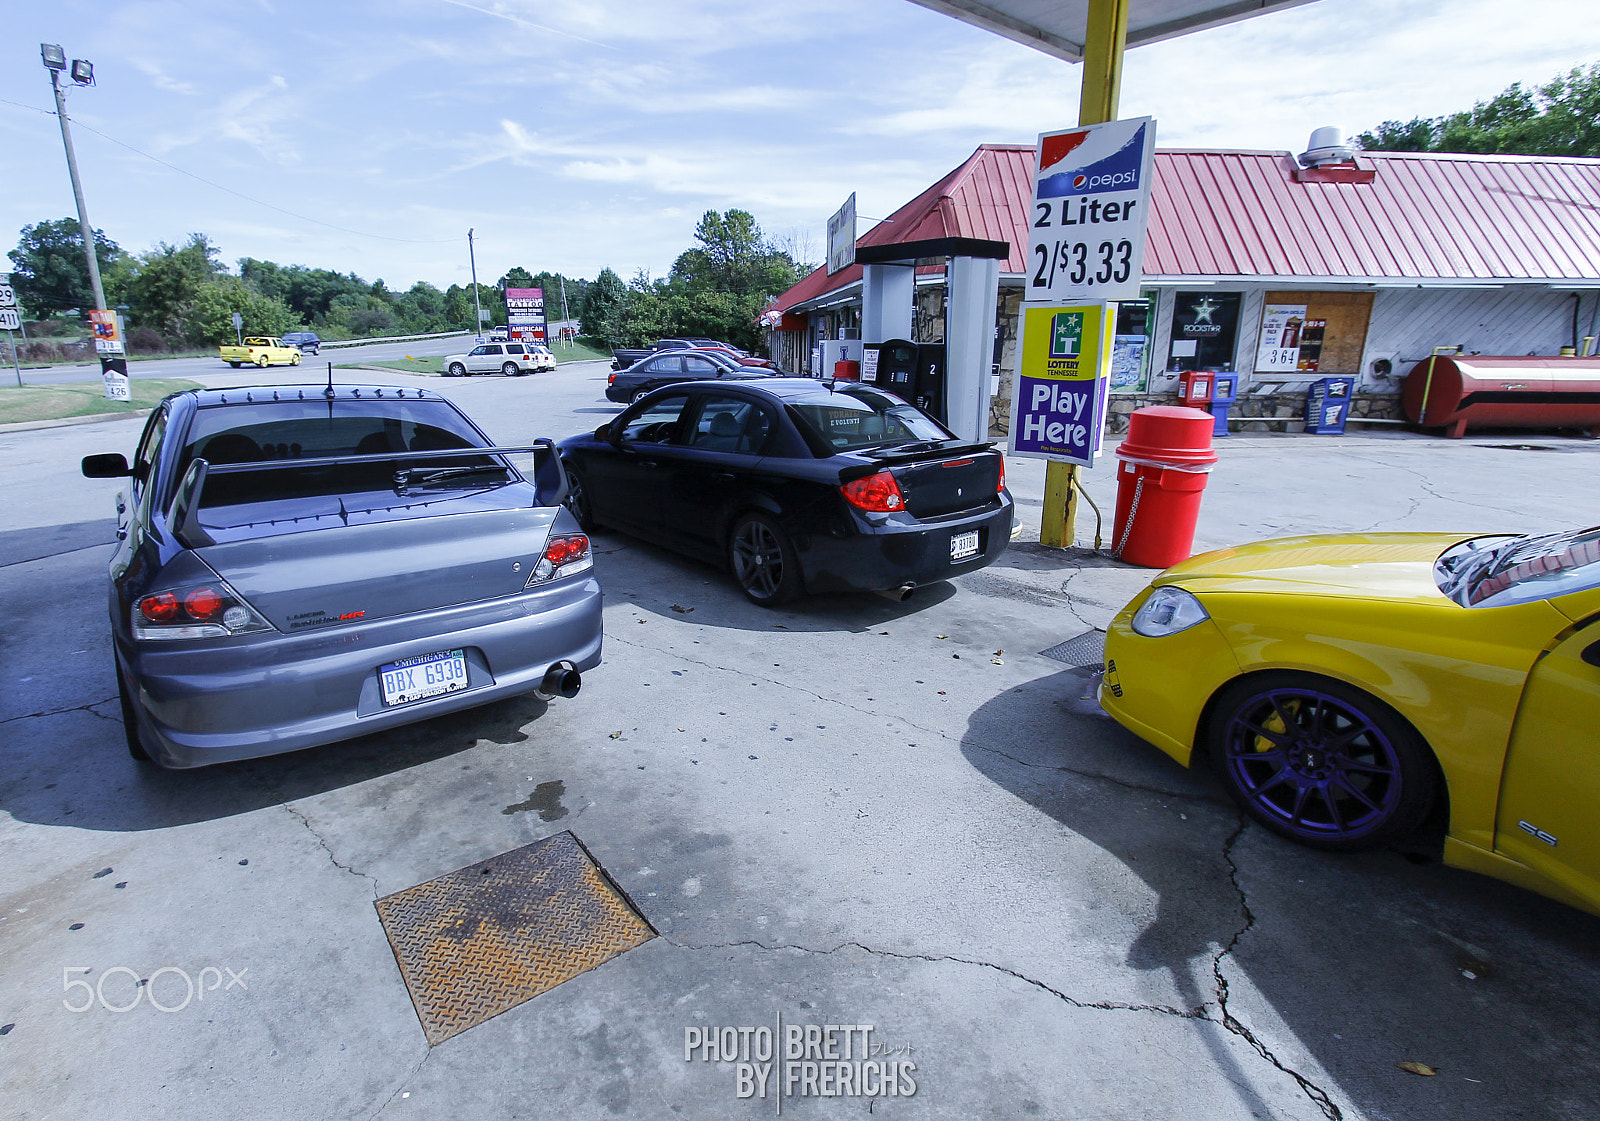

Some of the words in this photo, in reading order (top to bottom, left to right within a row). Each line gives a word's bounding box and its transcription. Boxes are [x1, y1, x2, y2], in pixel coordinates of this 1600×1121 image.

[1089, 169, 1136, 189] pepsi
[1034, 202, 1052, 228] 2
[1061, 197, 1137, 226] Liter
[1032, 240, 1132, 289] 2/$3.33
[930, 364, 936, 375] 2
[1046, 369, 1078, 377] TENNESSEE
[1047, 360, 1080, 369] LOTTERY
[1031, 384, 1088, 421] Play
[1023, 414, 1087, 447] Here
[339, 611, 366, 621] MR
[400, 653, 445, 667] MICHIGAN
[385, 669, 416, 694] BBX
[425, 659, 464, 685] 6938
[388, 696, 409, 706] DEALS
[408, 694, 422, 702] GAP
[422, 688, 446, 698] DRAGON
[1517, 820, 1559, 847] SS
